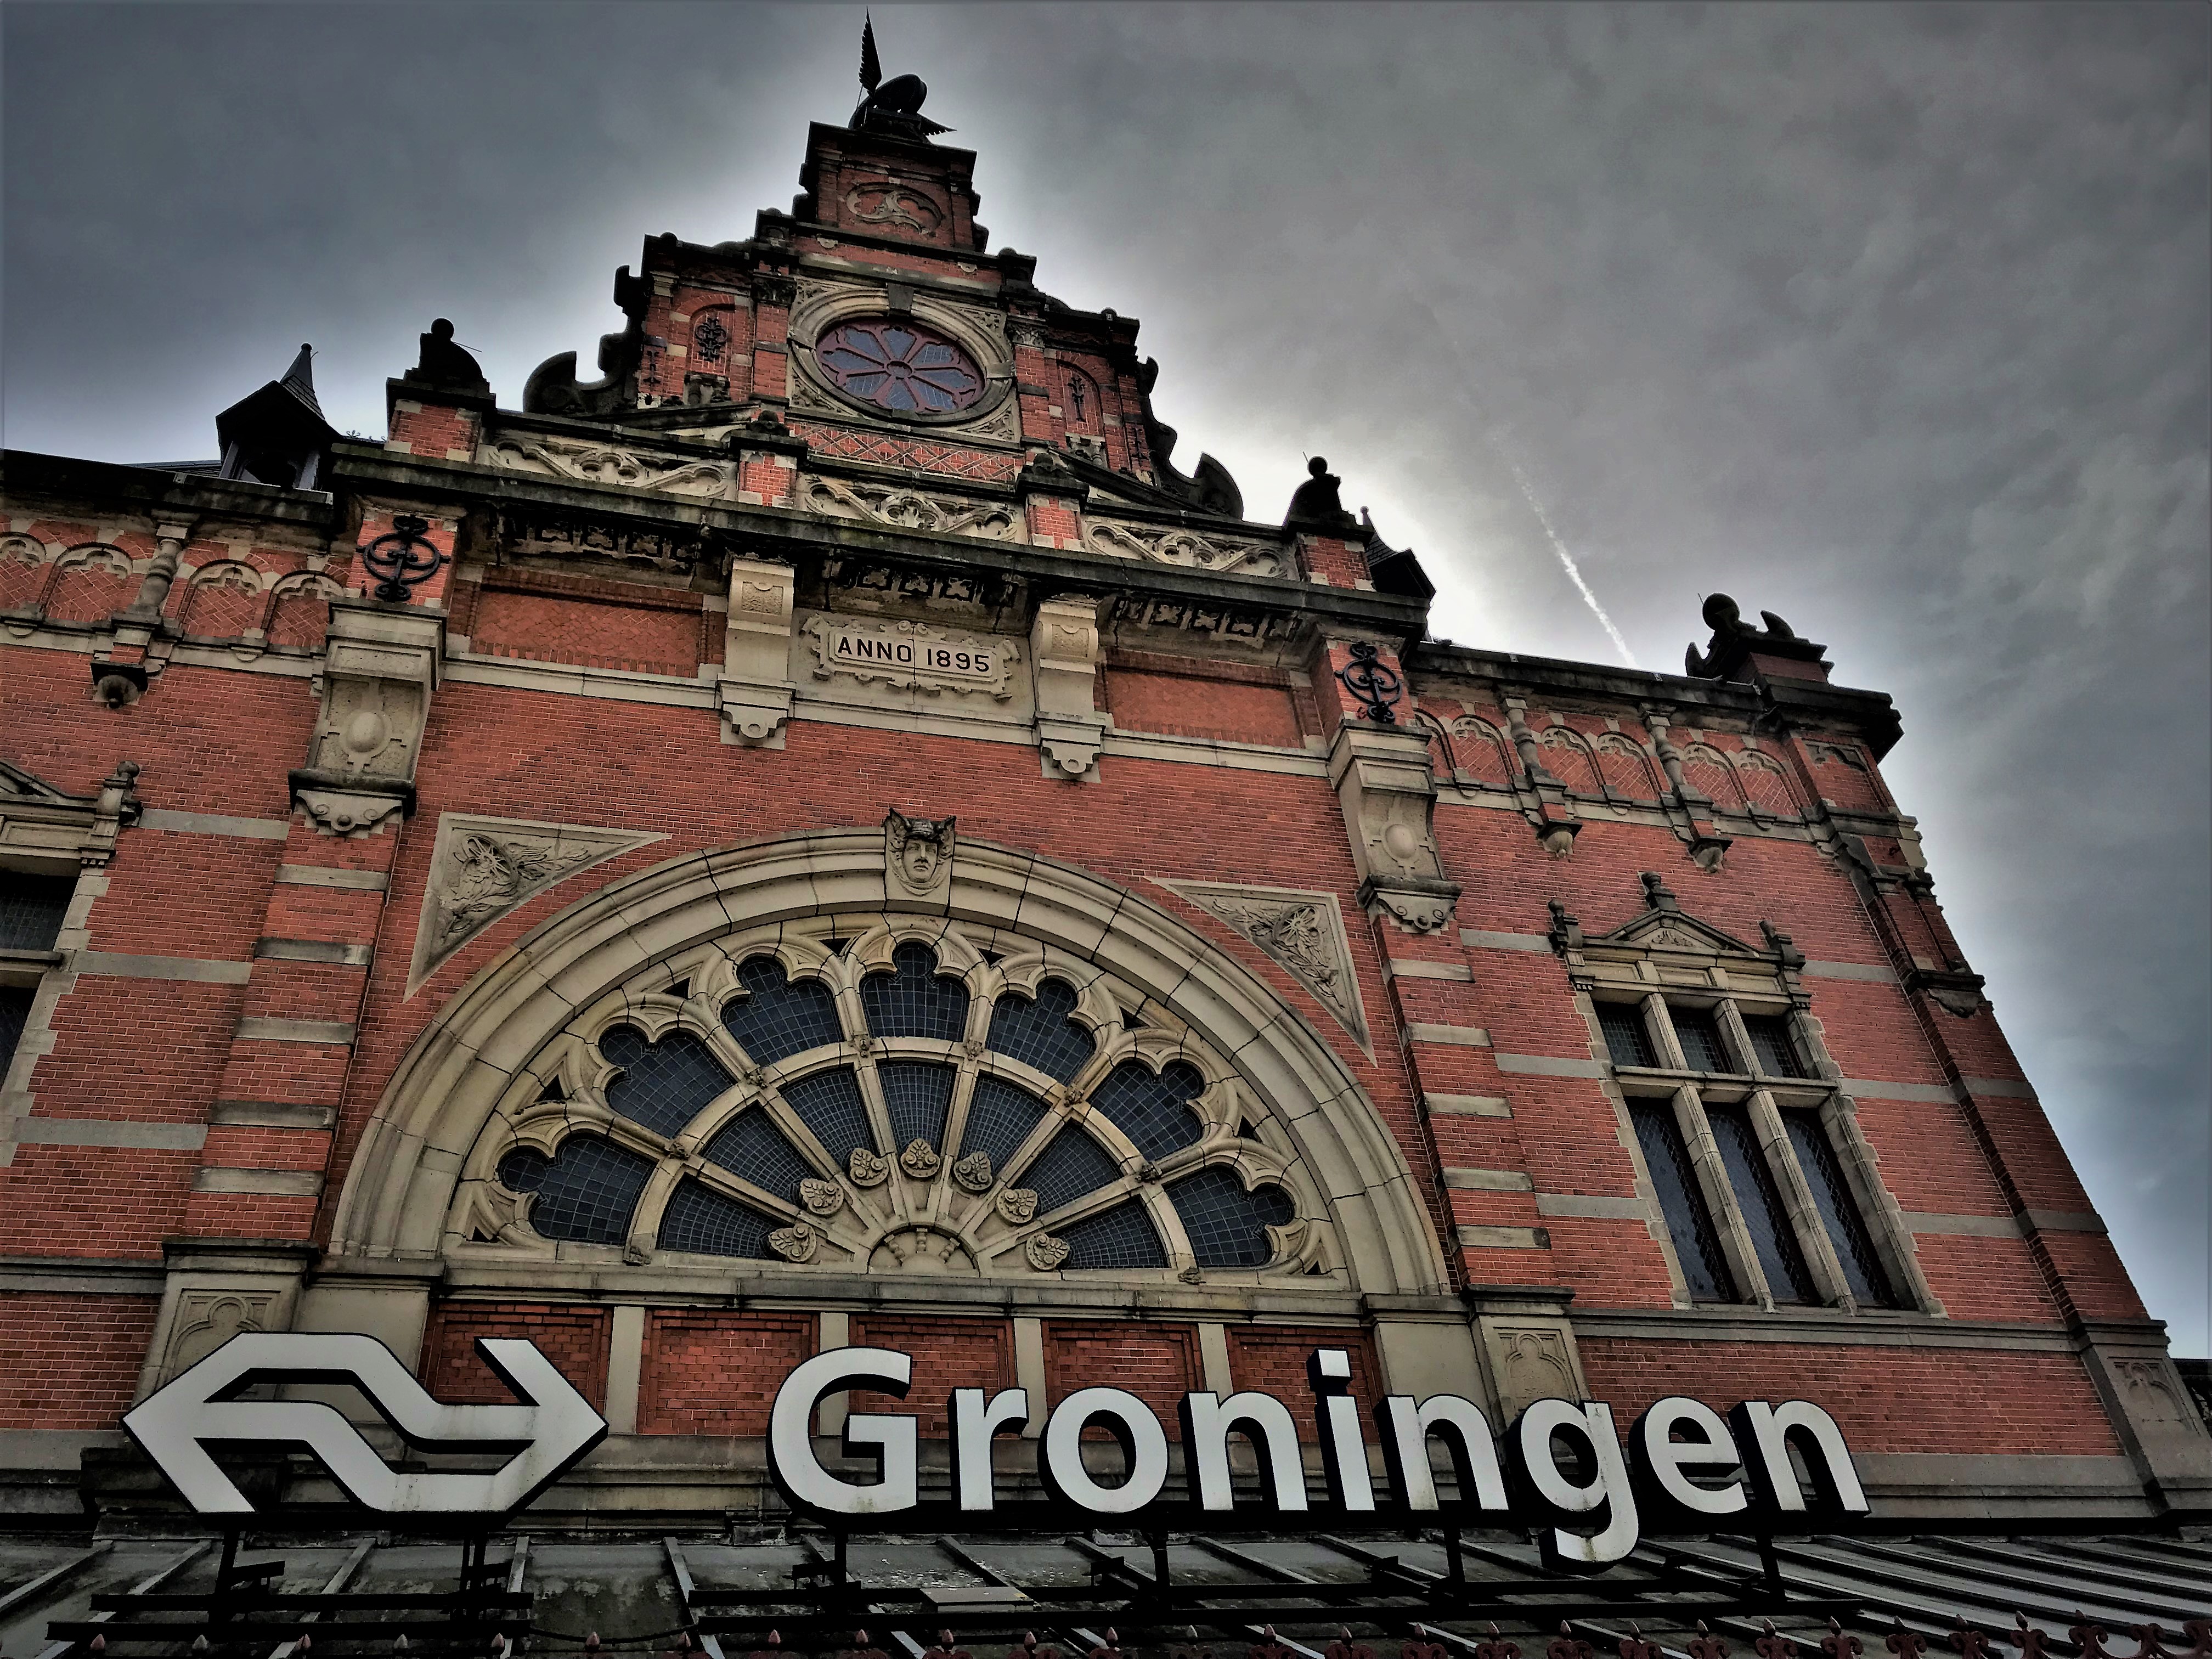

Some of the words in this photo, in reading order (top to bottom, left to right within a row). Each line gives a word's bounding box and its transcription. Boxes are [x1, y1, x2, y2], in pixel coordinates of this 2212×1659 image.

[837, 636, 912, 663] ANNO
[927, 648, 989, 672] 1895
[768, 1346, 1870, 1564] Groningen
